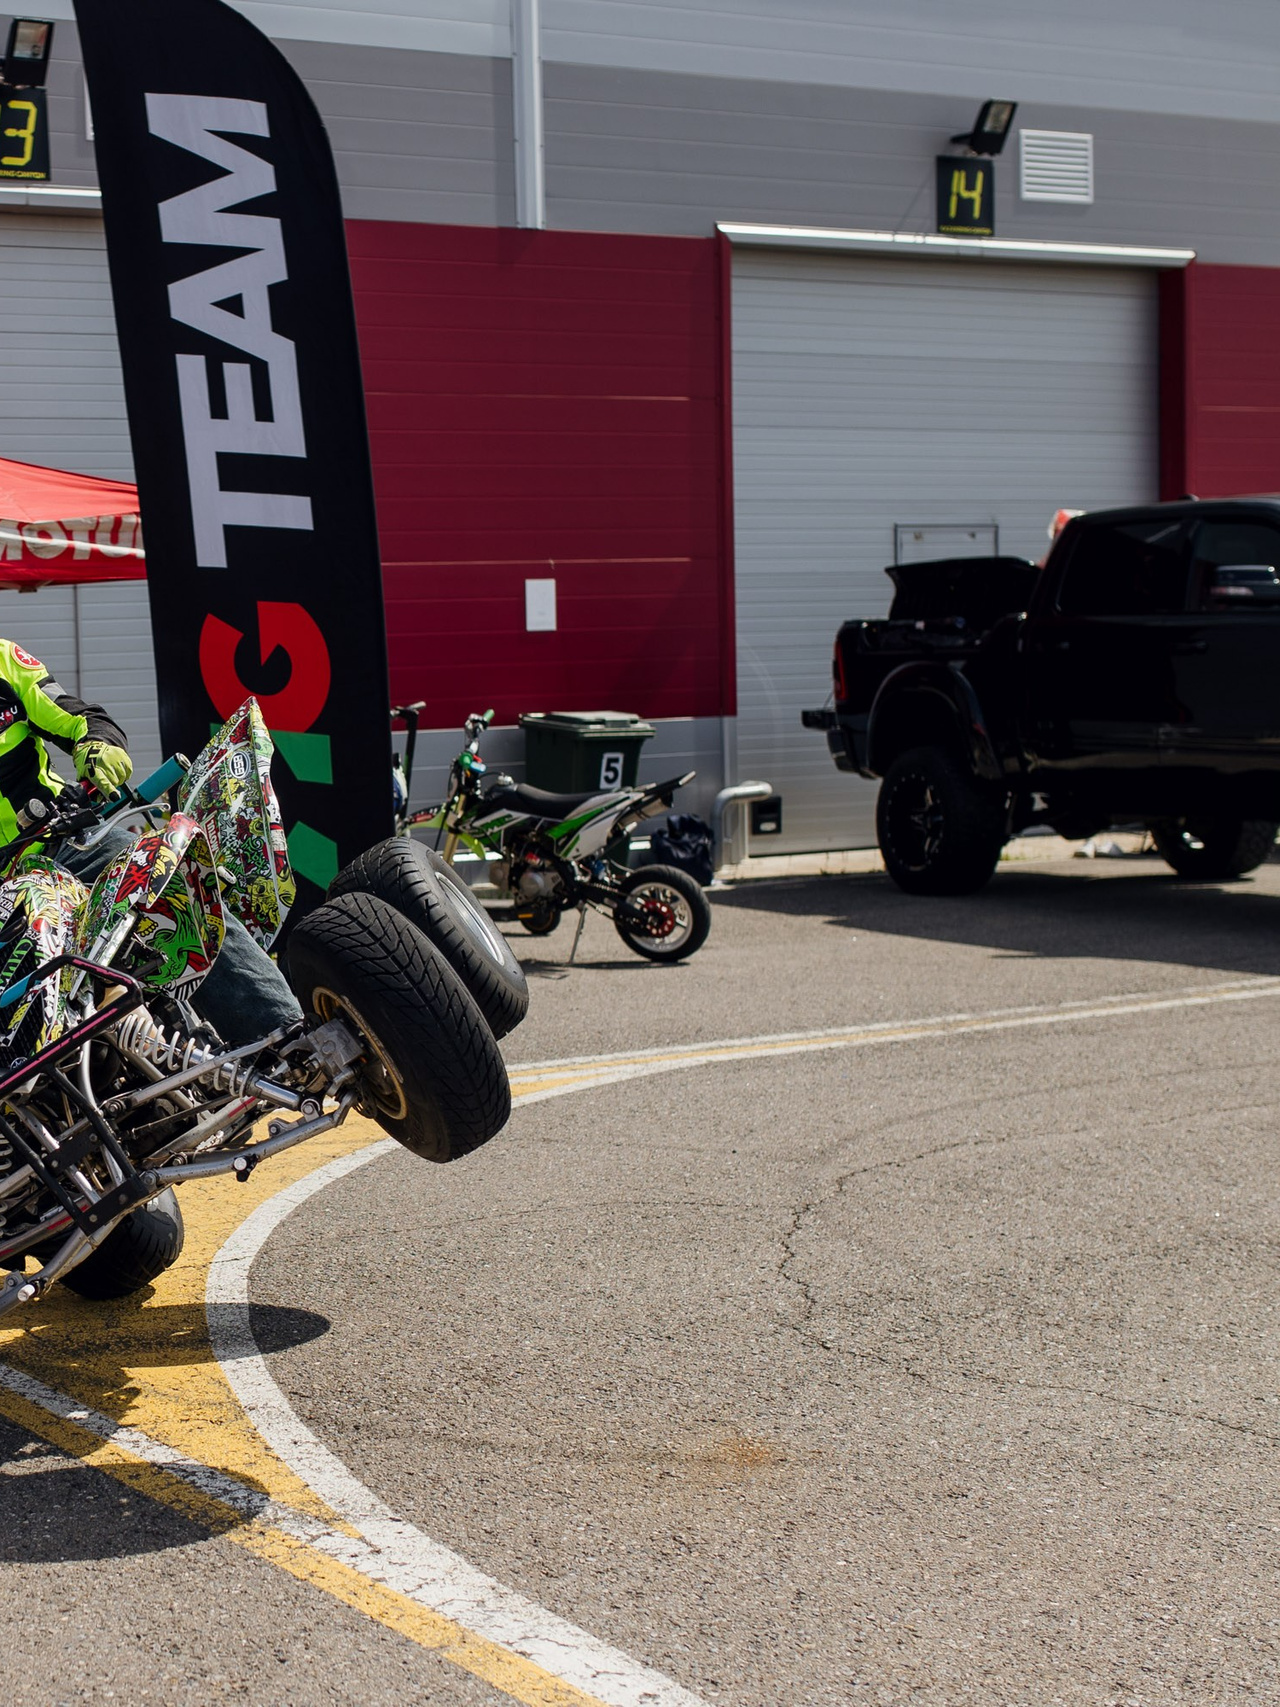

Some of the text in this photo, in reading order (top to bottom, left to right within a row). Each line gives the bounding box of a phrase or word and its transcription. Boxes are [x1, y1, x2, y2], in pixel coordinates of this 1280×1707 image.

[949, 170, 984, 219] 14
[143, 92, 314, 569] TEAM
[603, 757, 620, 784] 5
[206, 818, 220, 853] MOTUL
